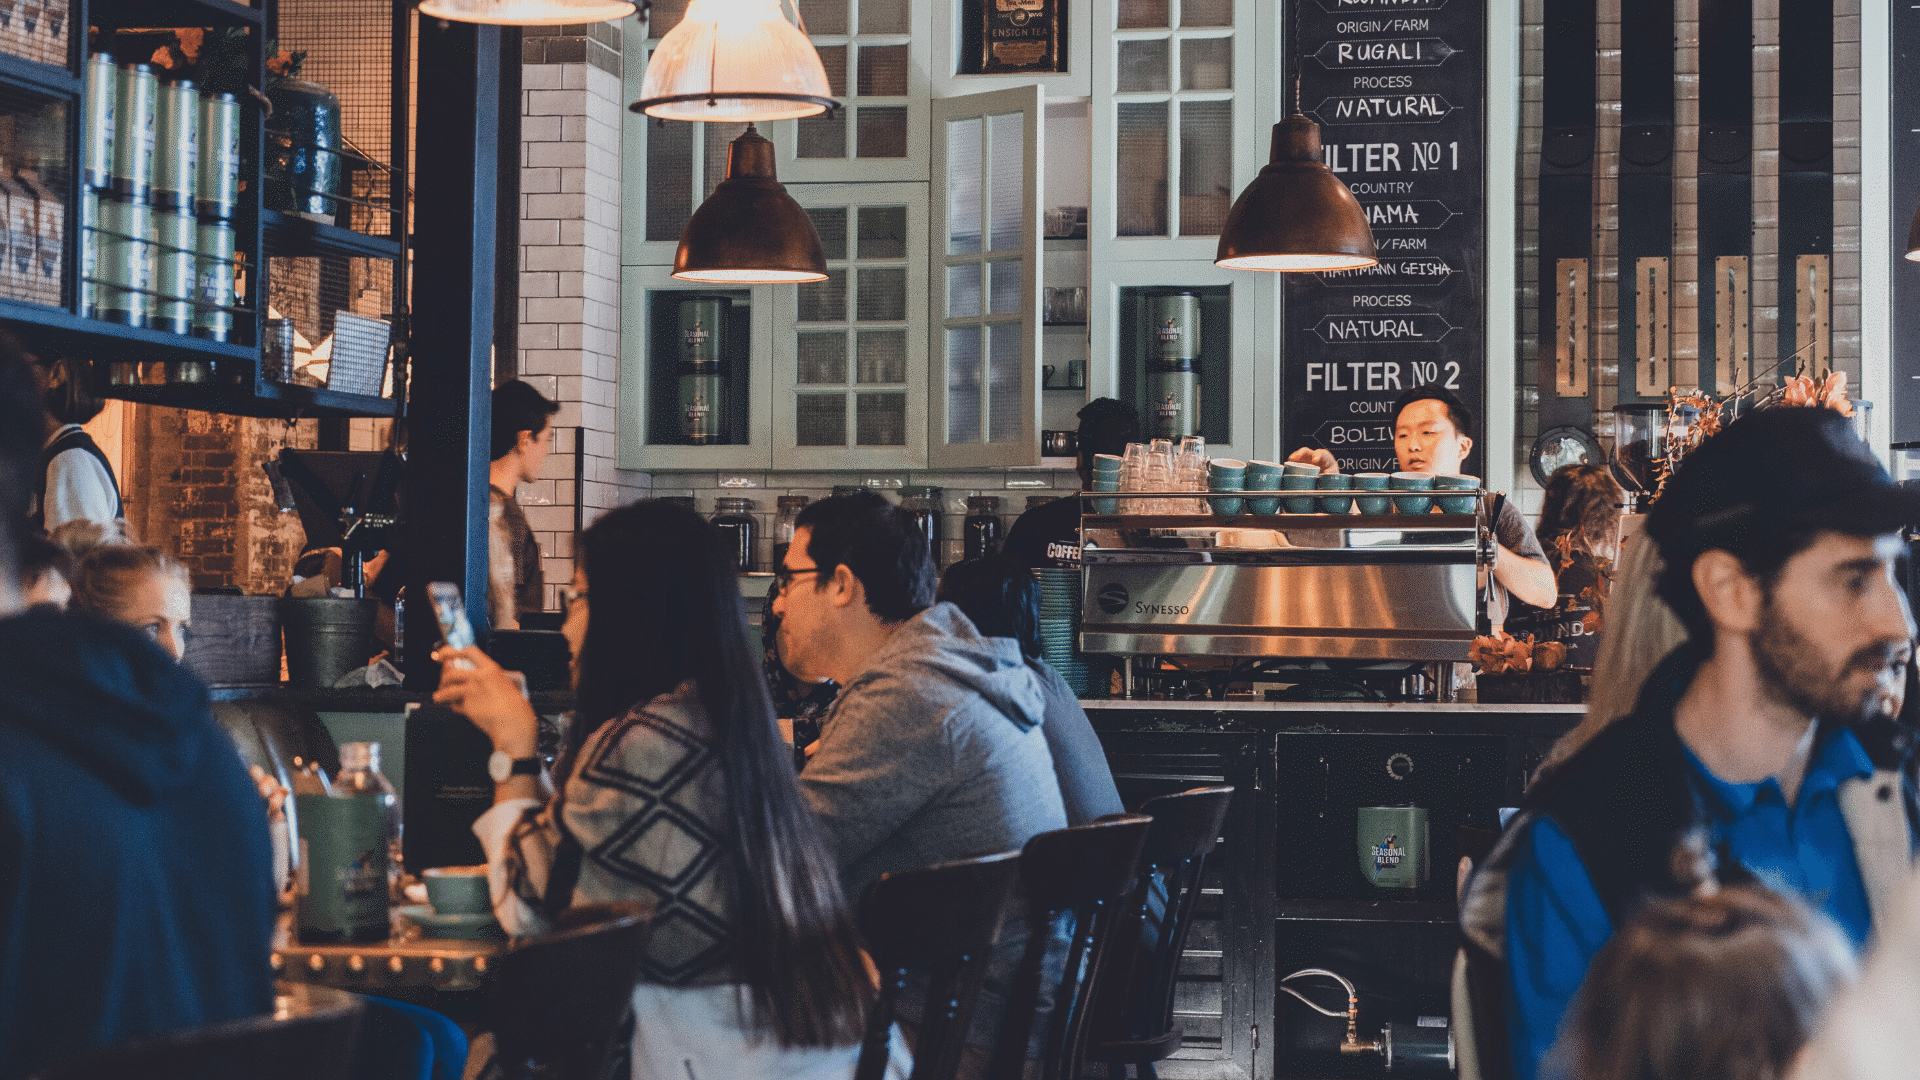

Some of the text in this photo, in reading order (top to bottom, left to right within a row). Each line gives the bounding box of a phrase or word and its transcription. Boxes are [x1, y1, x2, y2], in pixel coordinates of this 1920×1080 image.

[992, 27, 1048, 37] ENSIGN TEA
[1338, 42, 1421, 63] RUGALI
[1353, 76, 1412, 89] PROCESS
[1336, 97, 1445, 118] NATURAL
[1320, 142, 1401, 173] ILTER
[1449, 141, 1458, 171] 1
[1350, 182, 1414, 194] COUNTRY
[1365, 204, 1419, 224] NAMA
[1401, 262, 1451, 275] GEISHA
[1353, 295, 1412, 307] PROCESS
[1329, 320, 1423, 339] NATURAL
[1306, 362, 1401, 391] FILTER
[1444, 361, 1460, 389] 2
[1349, 401, 1395, 413] COUNT
[1047, 542, 1081, 560] COFFE
[1371, 845, 1406, 857] SEASONAL
